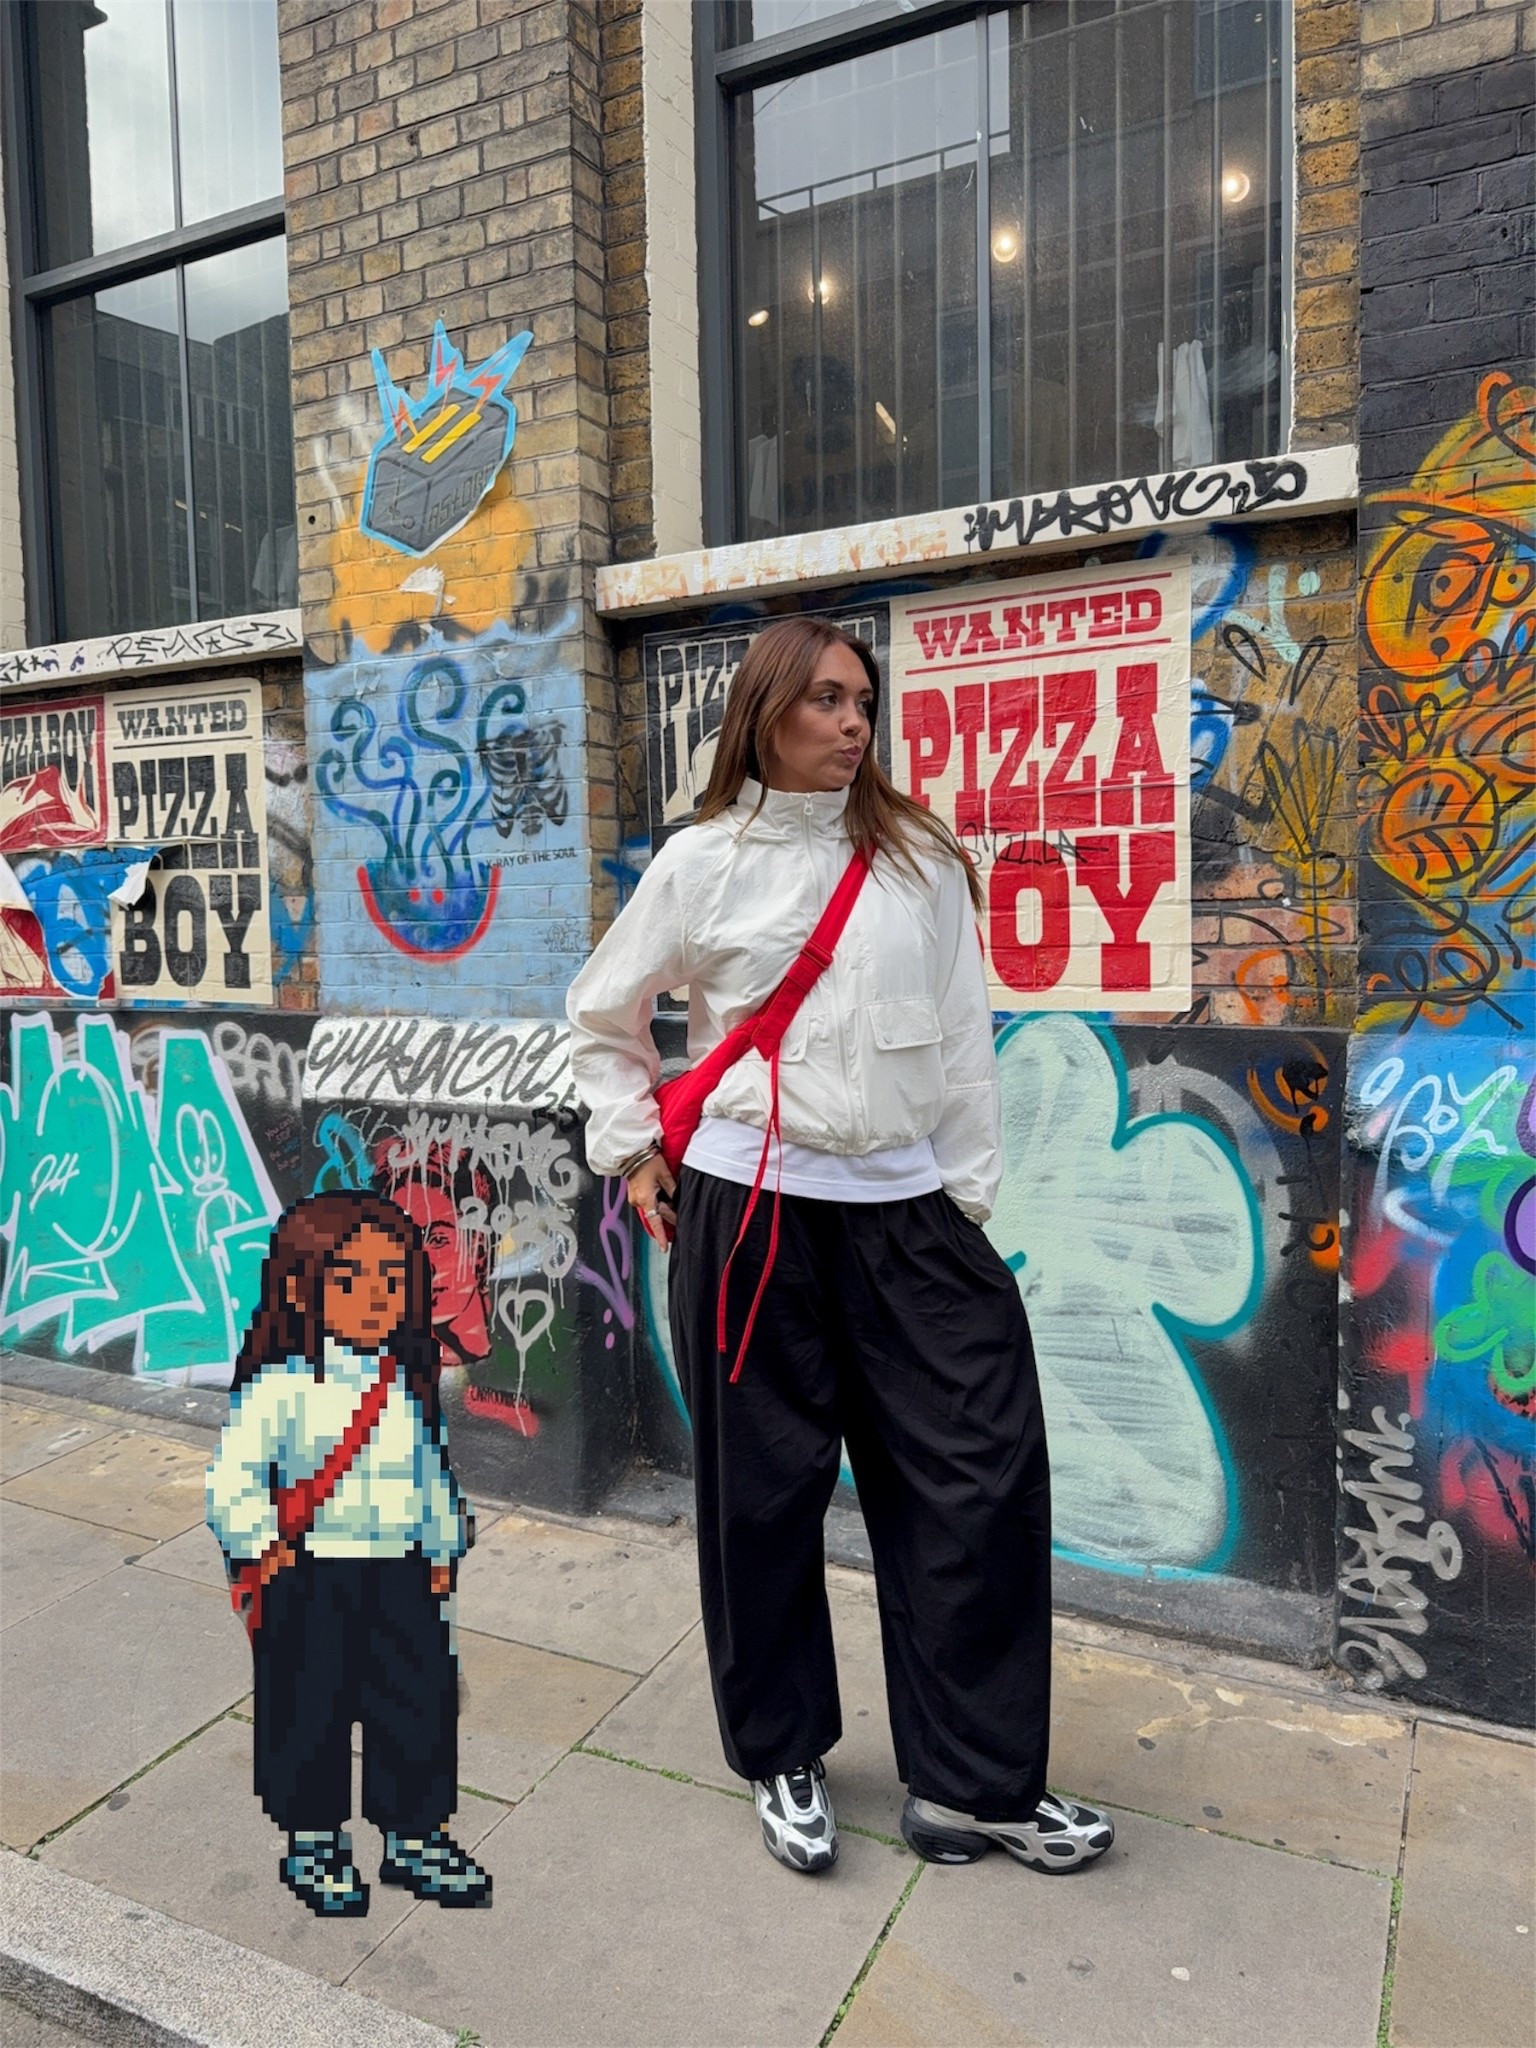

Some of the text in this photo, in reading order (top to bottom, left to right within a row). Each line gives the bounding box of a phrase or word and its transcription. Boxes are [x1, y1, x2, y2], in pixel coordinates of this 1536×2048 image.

[914, 589, 1162, 661] WANTED
[117, 700, 248, 742] WANTED
[902, 664, 1176, 831] PIZZA
[112, 753, 260, 870] PIZZA
[517, 853, 531, 865] OF
[533, 852, 551, 863] THE
[552, 846, 578, 860] SOUL
[118, 874, 262, 989] BOY
[966, 831, 1176, 992] OY
